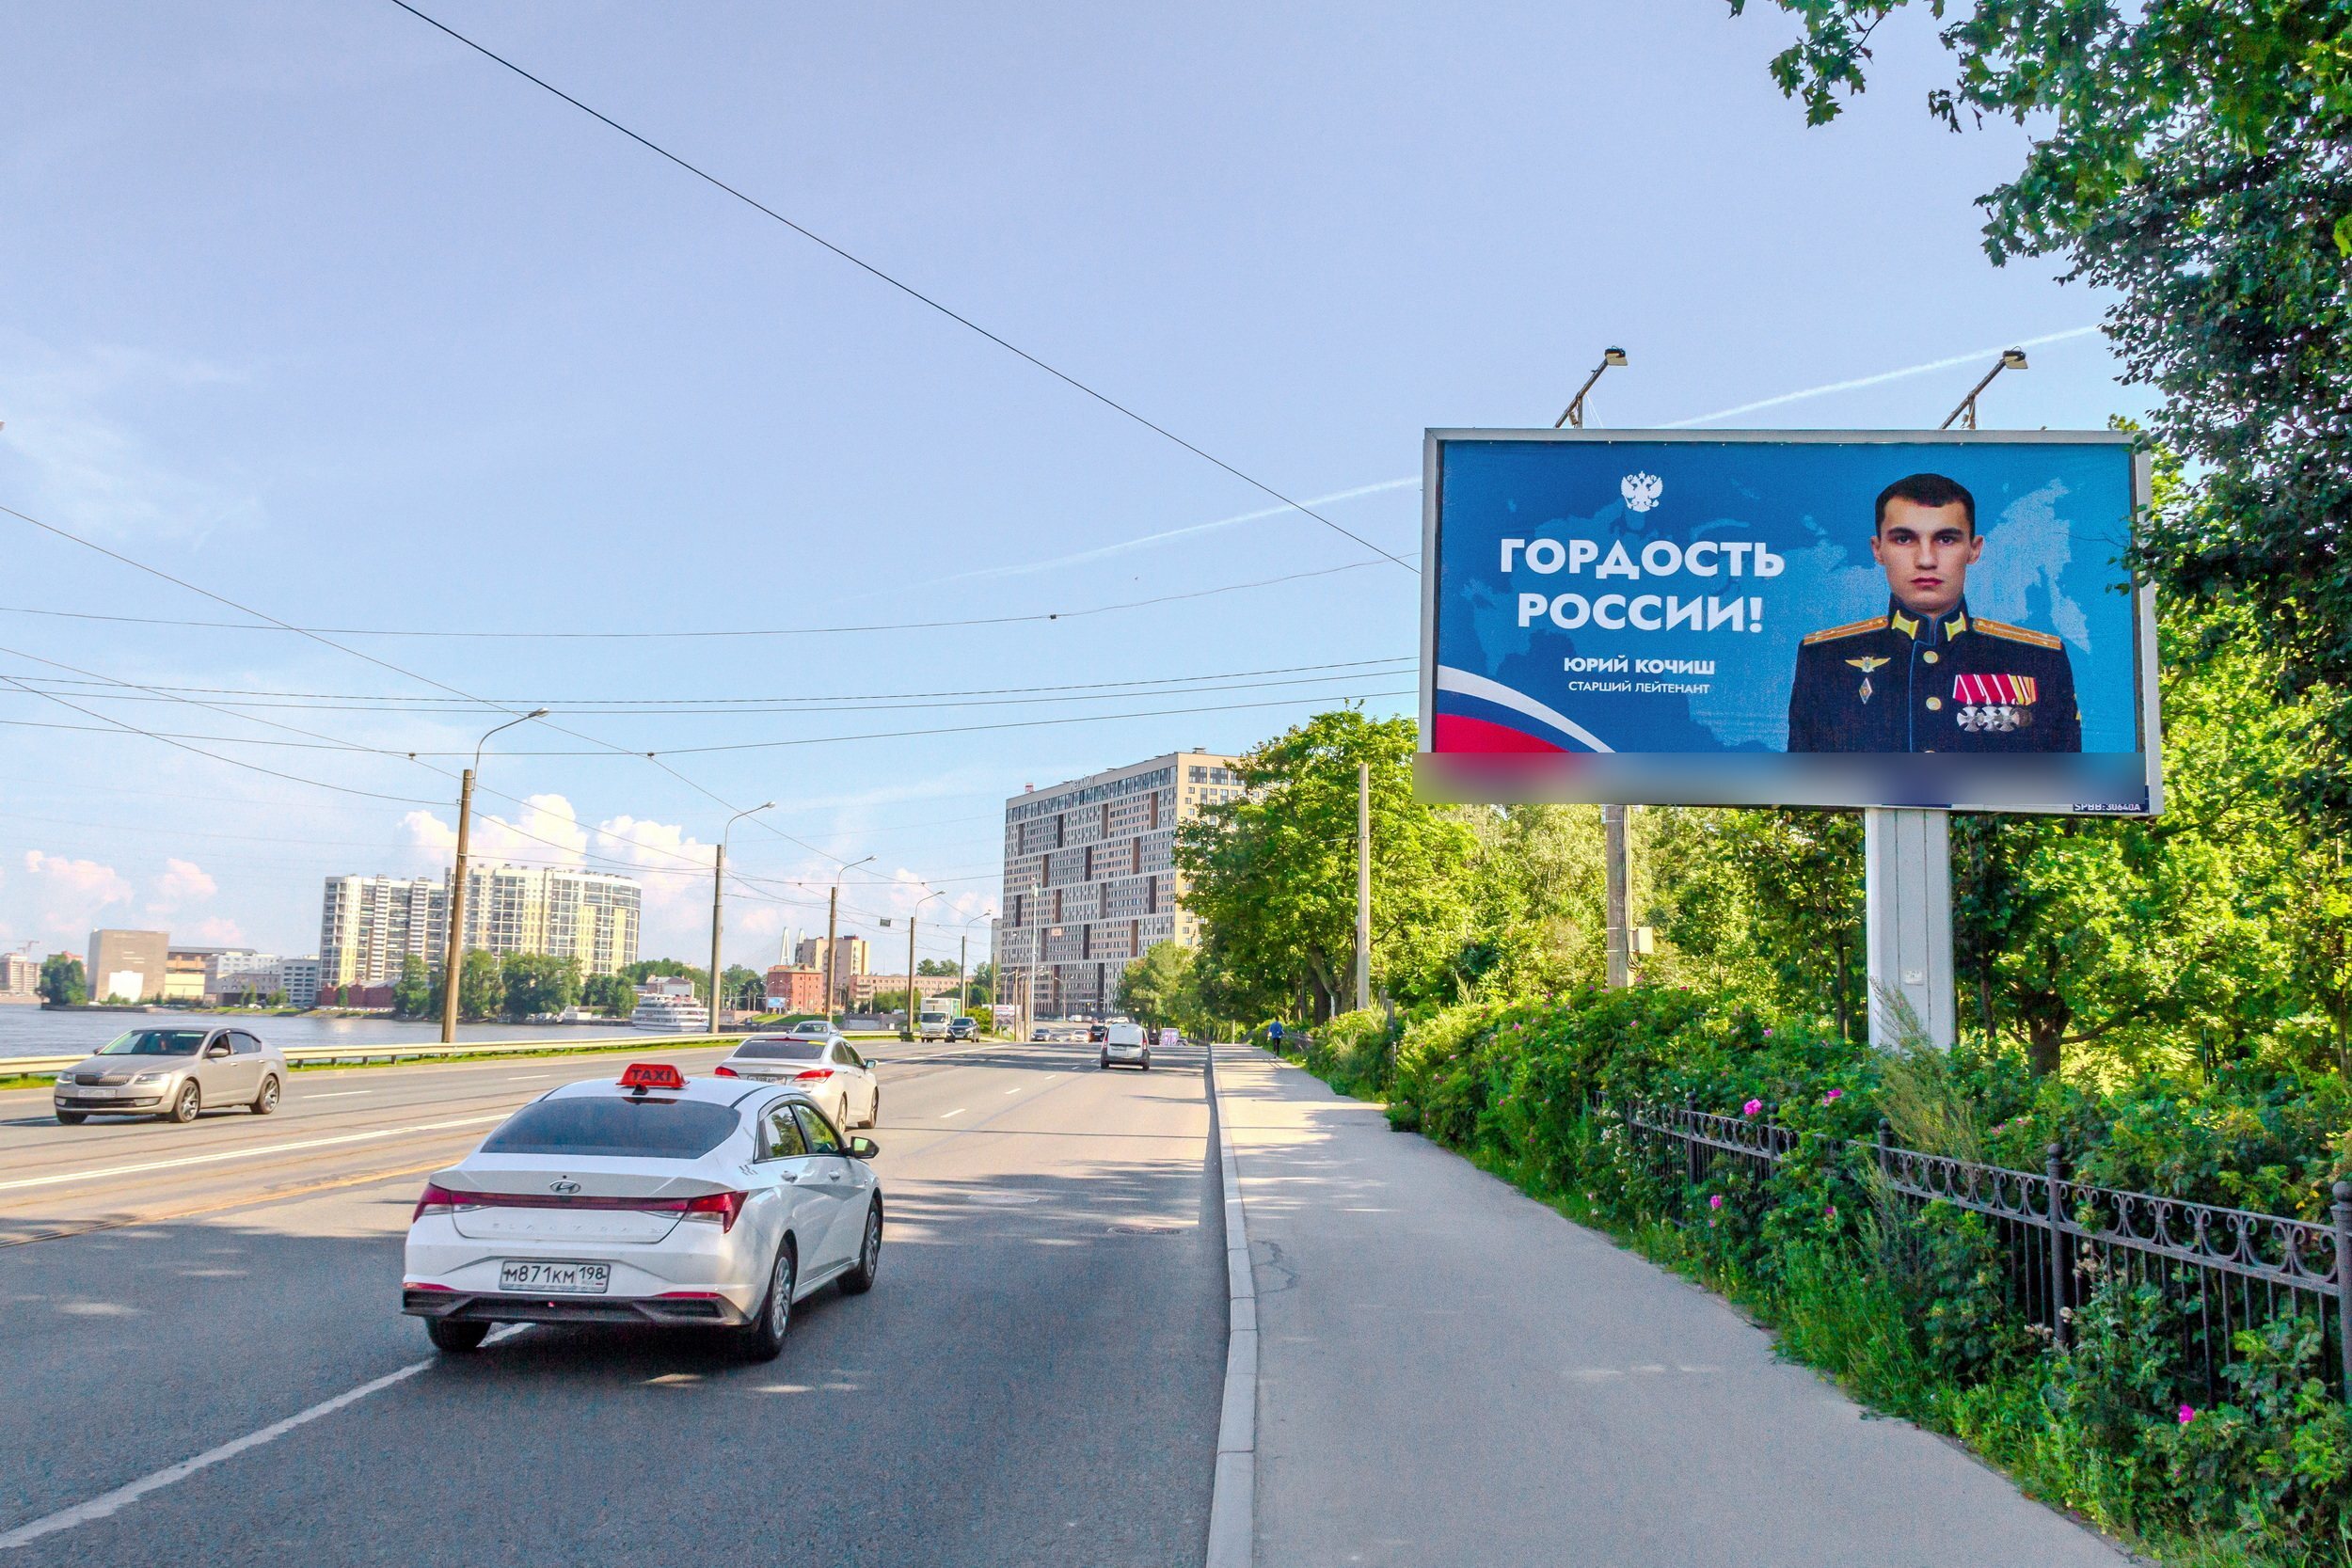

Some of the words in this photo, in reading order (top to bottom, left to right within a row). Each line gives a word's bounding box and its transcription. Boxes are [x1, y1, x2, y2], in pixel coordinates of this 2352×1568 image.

[1501, 538, 1786, 580] ГОРДОСТЬ
[1518, 593, 1762, 633] РОССИИ!
[1564, 655, 1629, 673] ЮРИЙ
[1635, 658, 1715, 675] КОЧИШ
[1568, 681, 1631, 692] СТАРШИЙ
[1635, 681, 1710, 694] ЛЕЙТЕНАНТ
[631, 1069, 672, 1082] TAXI
[579, 1266, 604, 1280] 198
